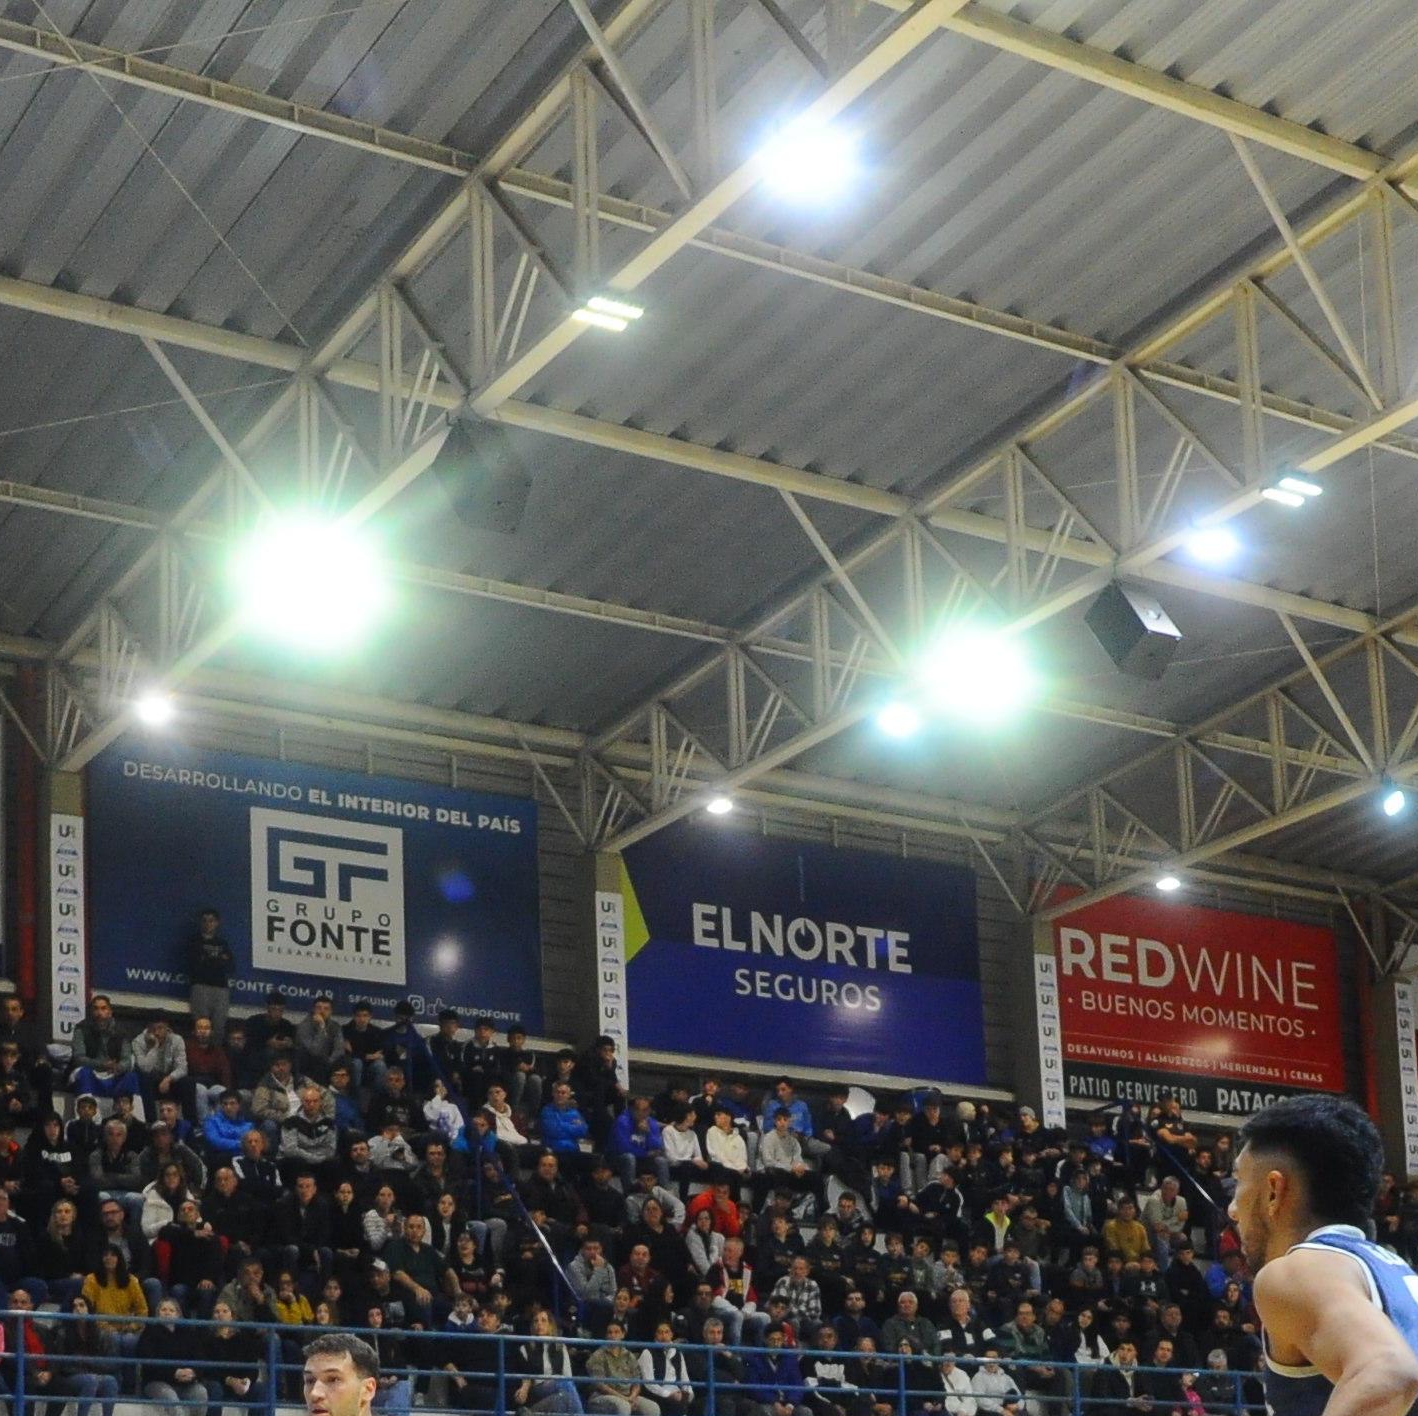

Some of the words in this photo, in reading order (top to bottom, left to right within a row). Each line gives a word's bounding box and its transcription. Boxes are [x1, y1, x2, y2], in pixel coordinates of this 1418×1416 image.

[123, 760, 303, 802] DESARROLLANDO
[308, 788, 332, 806] EL
[337, 792, 430, 820] INTERIOR
[435, 807, 473, 827] DEL
[477, 814, 522, 835] PAÍS
[266, 898, 392, 928] GRUPO
[267, 914, 392, 957] FONTE
[735, 967, 882, 1012] SEGUROS
[1081, 990, 1175, 1022] BUENOS
[1181, 1003, 1305, 1039] MOMENTOS
[1069, 1074, 1110, 1098] PATIO
[1290, 1070, 1323, 1083] CENAS
